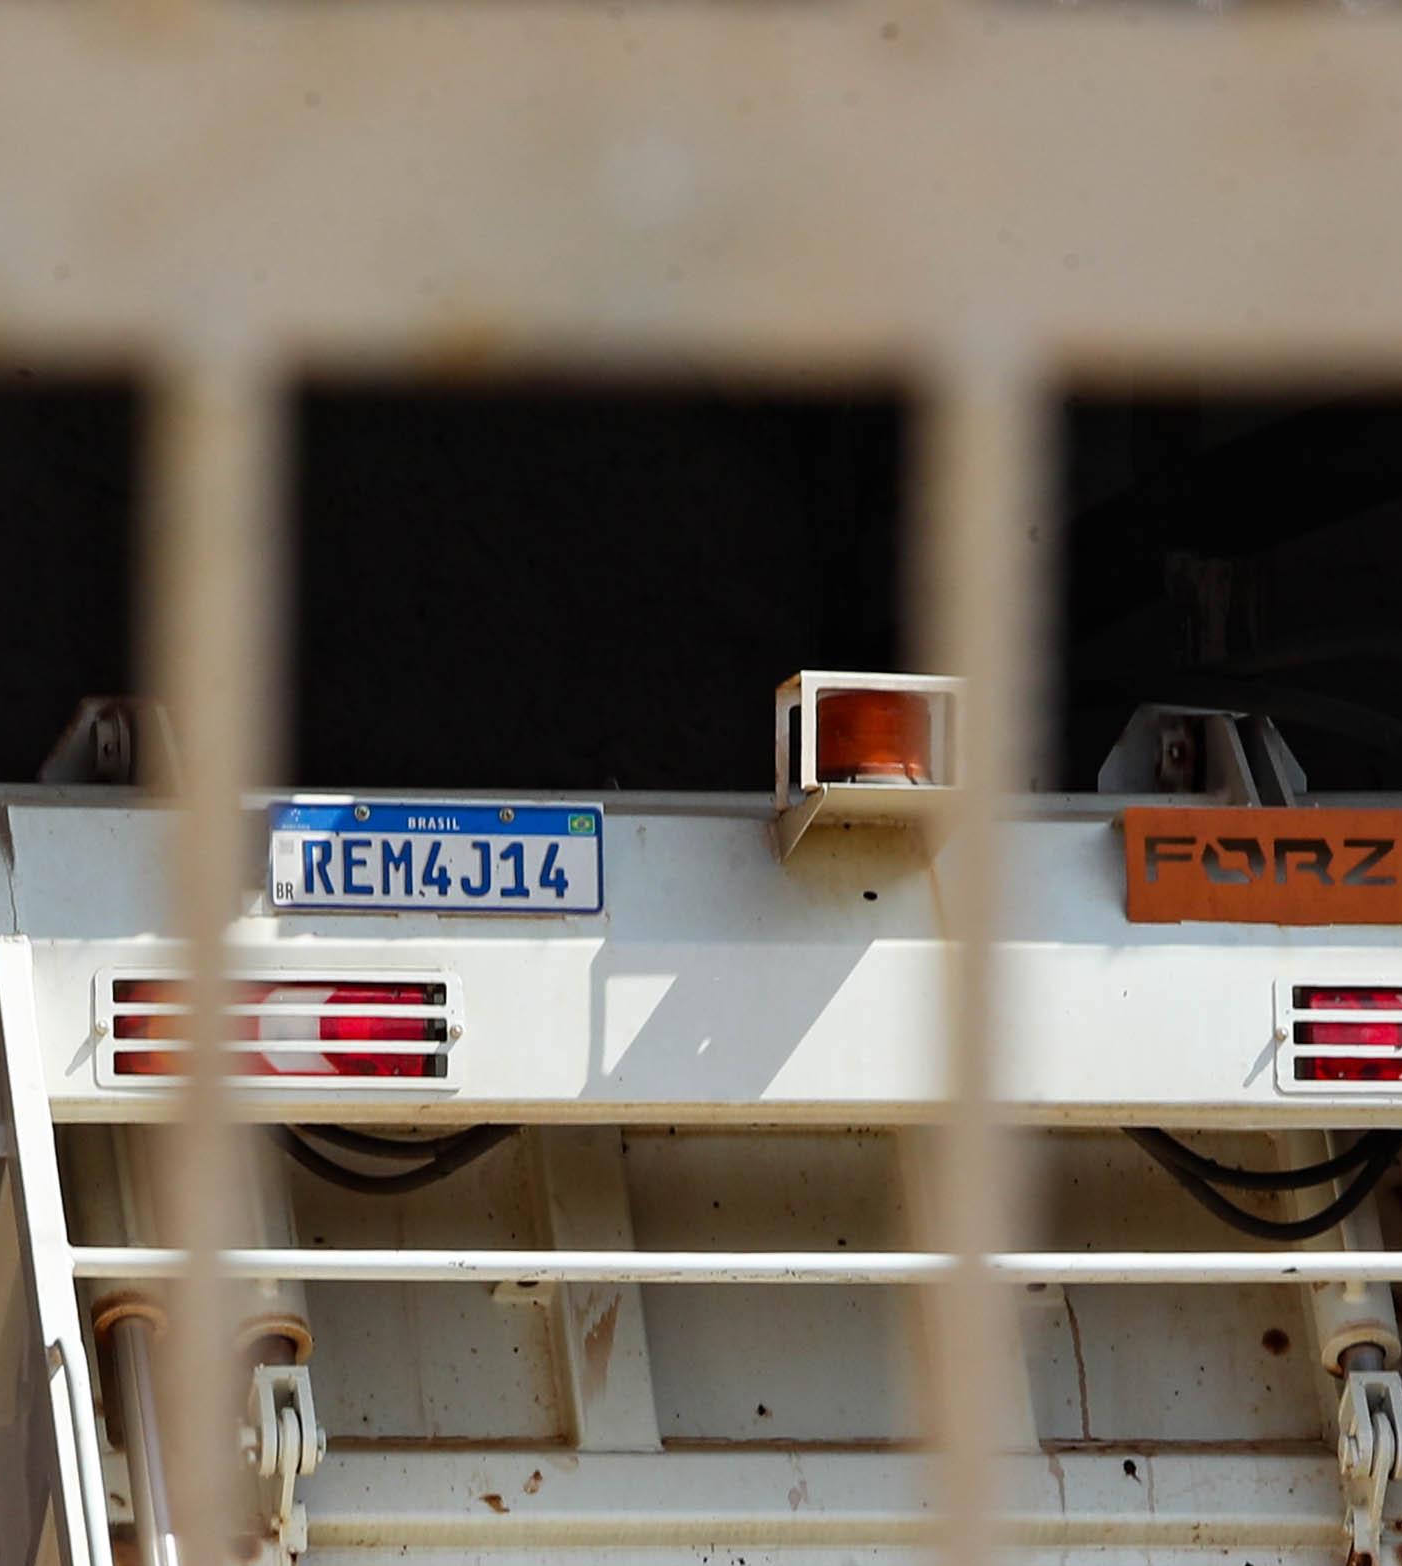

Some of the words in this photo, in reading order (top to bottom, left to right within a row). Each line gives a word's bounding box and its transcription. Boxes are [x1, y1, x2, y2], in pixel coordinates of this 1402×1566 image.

[407, 816, 460, 832] BRASIL
[301, 838, 570, 898] REM4J14
[275, 880, 295, 900] BR
